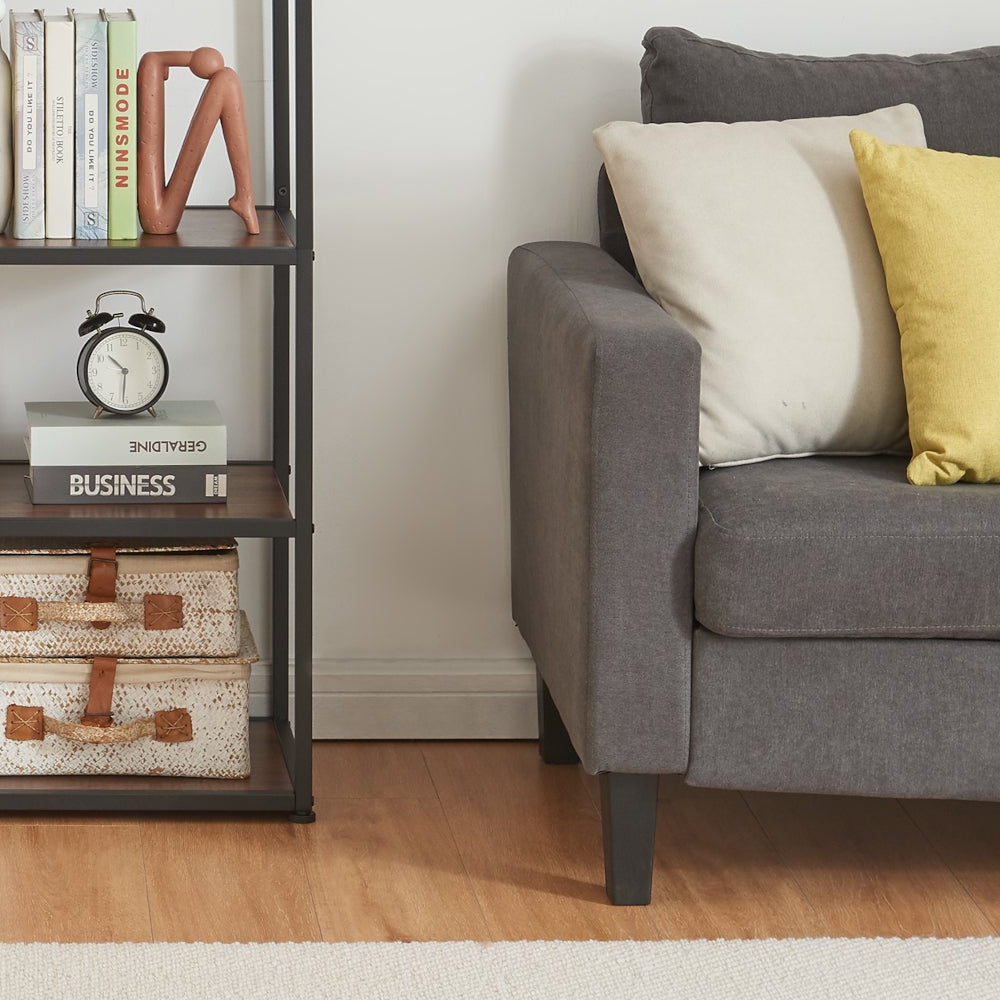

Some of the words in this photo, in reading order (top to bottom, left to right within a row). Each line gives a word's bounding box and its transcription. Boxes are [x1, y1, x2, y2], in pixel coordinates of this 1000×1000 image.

[91, 41, 99, 89] SIDESHOW
[27, 80, 33, 91] IT
[56, 96, 64, 137] STILETTO
[88, 110, 95, 123] DO
[115, 68, 130, 188] NINSMODE
[27, 139, 33, 153] DO
[56, 140, 64, 165] BOOK
[88, 173, 95, 183] IT
[22, 175, 30, 222] SIDESHOW
[120, 338, 128, 347] 12
[147, 351, 152, 360] 2
[129, 440, 207, 453] GERALDINE
[69, 474, 176, 496] BUSINESS
